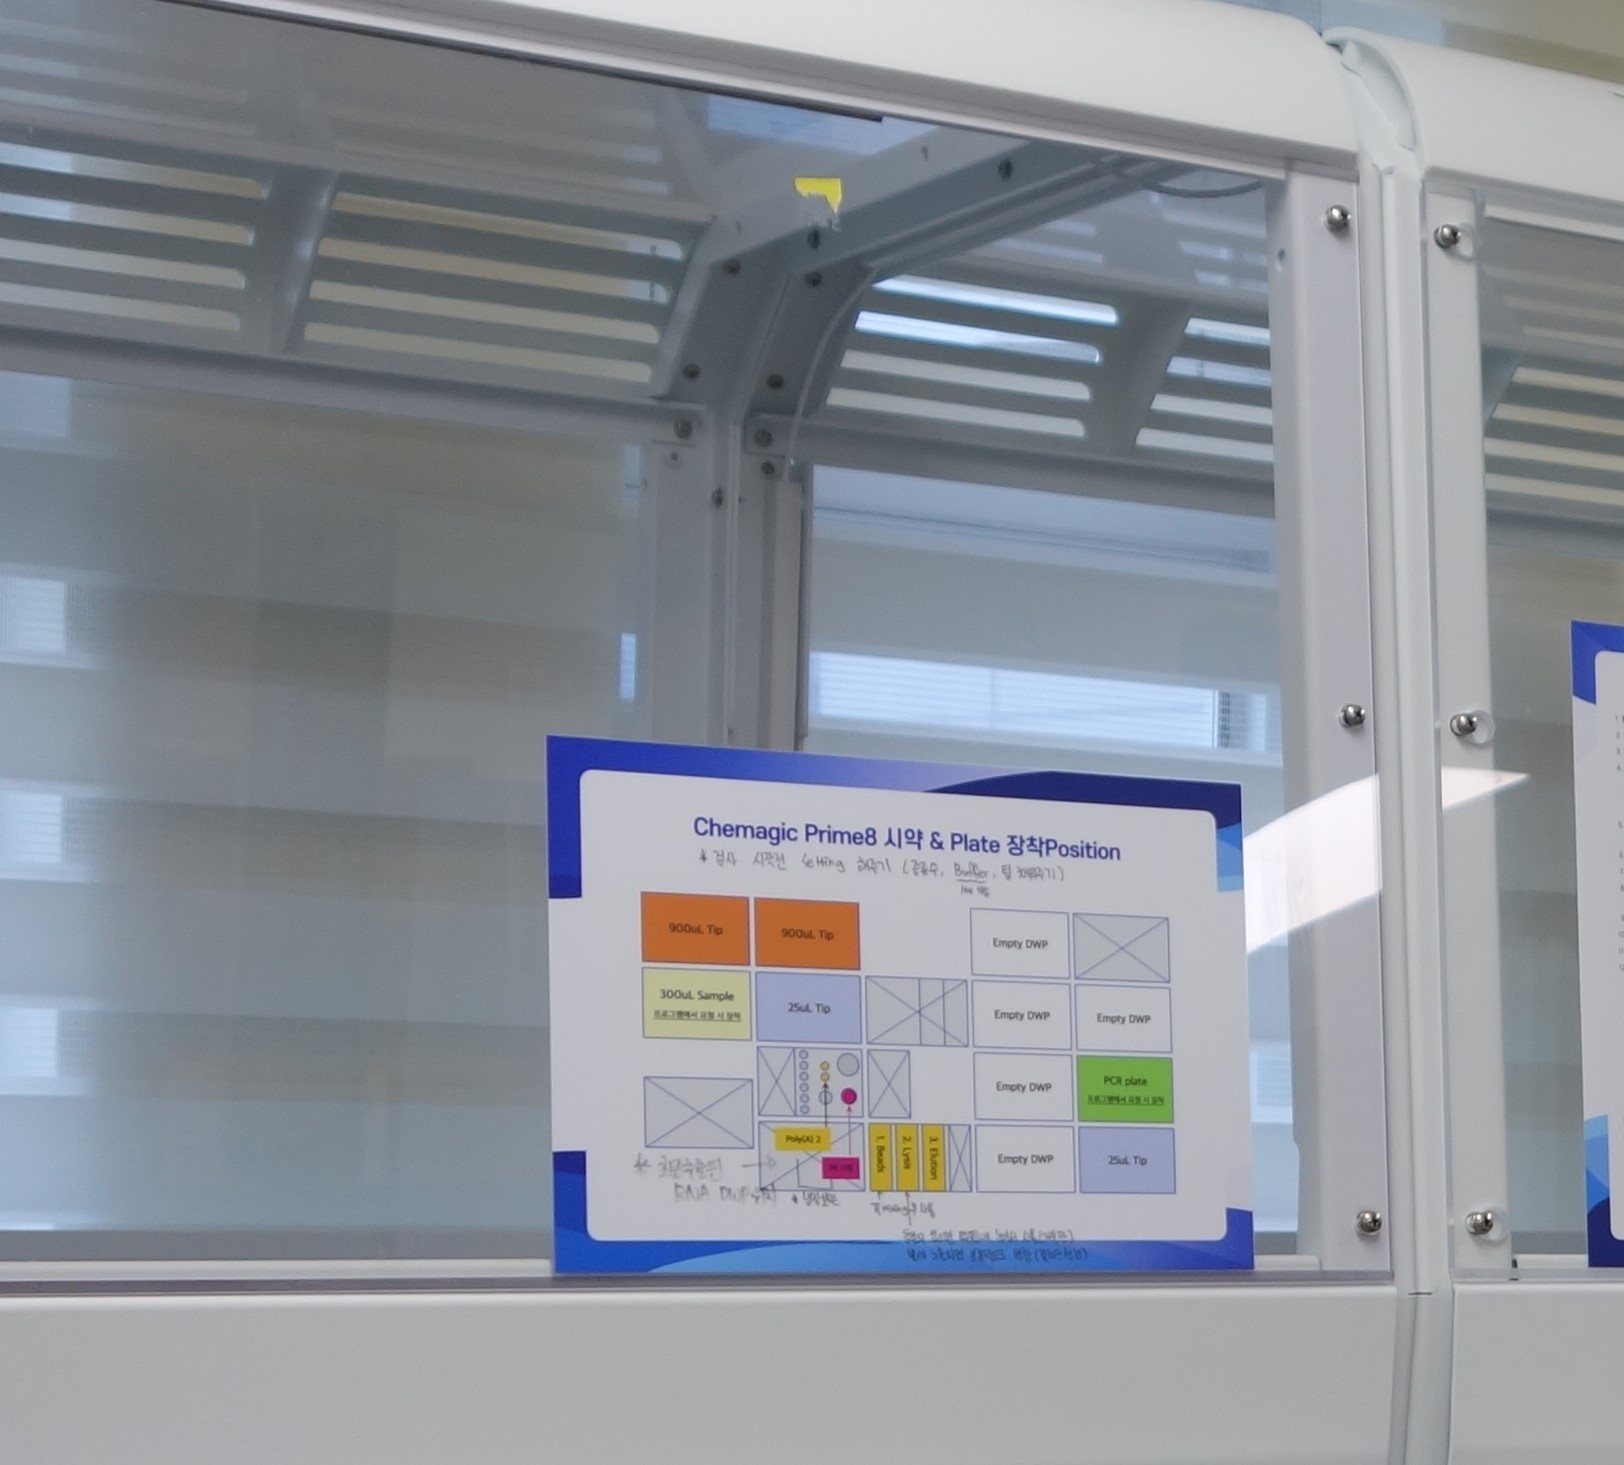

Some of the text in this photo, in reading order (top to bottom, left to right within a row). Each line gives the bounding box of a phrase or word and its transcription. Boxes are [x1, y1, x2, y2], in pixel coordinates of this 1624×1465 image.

[693, 816, 1121, 861] Chemagic Prime8 시약 & Plate 장착Position
[669, 922, 723, 936] 900uL Tip
[781, 927, 834, 941] 900uL Tip
[992, 937, 1048, 949] Empty DWP
[659, 989, 735, 1003] 300uL Sample
[787, 1002, 831, 1015] 25uL Tip
[994, 1009, 1050, 1021] Empty DWP
[1096, 1013, 1151, 1025] Empty DWP
[996, 1081, 1052, 1093] Empty DWP
[1103, 1075, 1148, 1087] PCR plate
[815, 1135, 822, 1144] 2
[875, 1145, 886, 1173] Beads
[902, 1146, 911, 1170] Lysis
[929, 1145, 938, 1180] Elution
[997, 1153, 1054, 1165] Empty DWP
[1107, 1155, 1148, 1166] 25uL Tip
